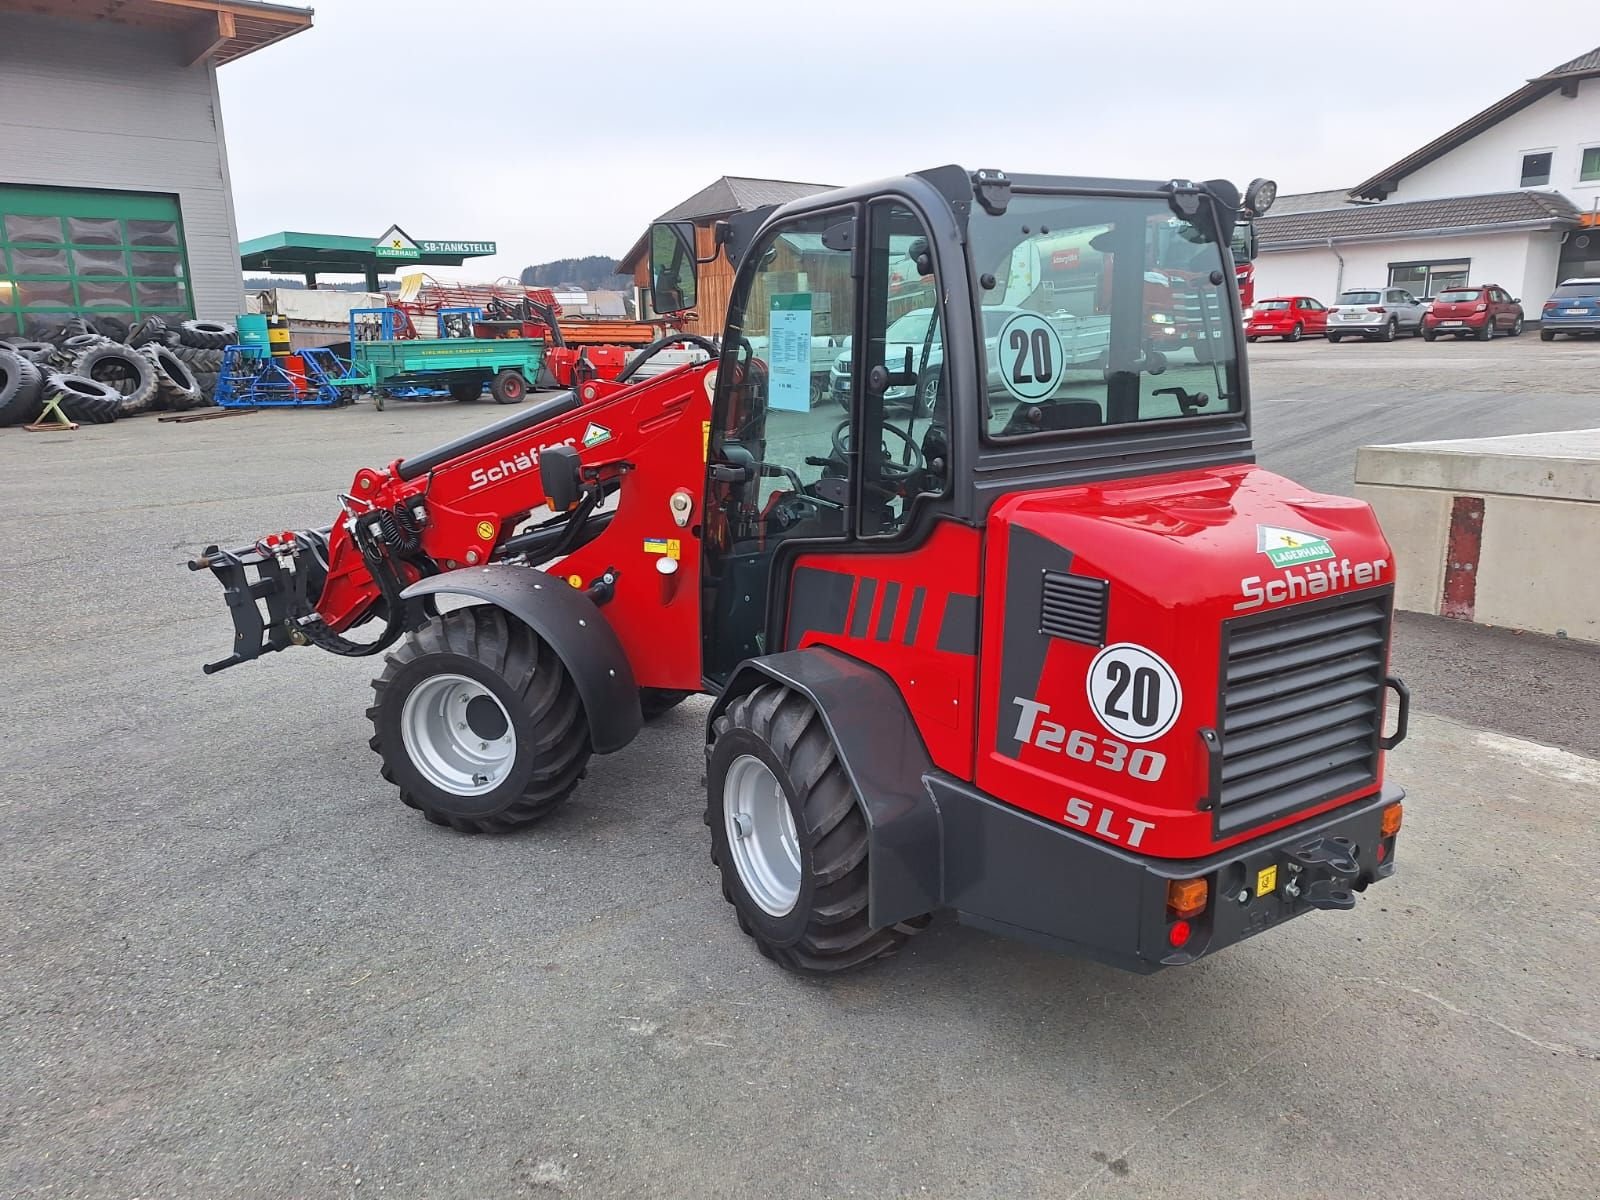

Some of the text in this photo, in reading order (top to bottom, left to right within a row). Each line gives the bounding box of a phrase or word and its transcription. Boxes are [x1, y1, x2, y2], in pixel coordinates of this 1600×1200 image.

[378, 249, 418, 257] LAGERHAUS
[423, 242, 495, 253] SB-TANKSTELLE
[1010, 328, 1053, 384] 20
[1272, 544, 1330, 563] LAGERHAUS
[1233, 558, 1388, 611] Schäffer
[1105, 660, 1160, 727] 20
[1013, 696, 1167, 782] T2630
[1063, 797, 1156, 848] SLT
